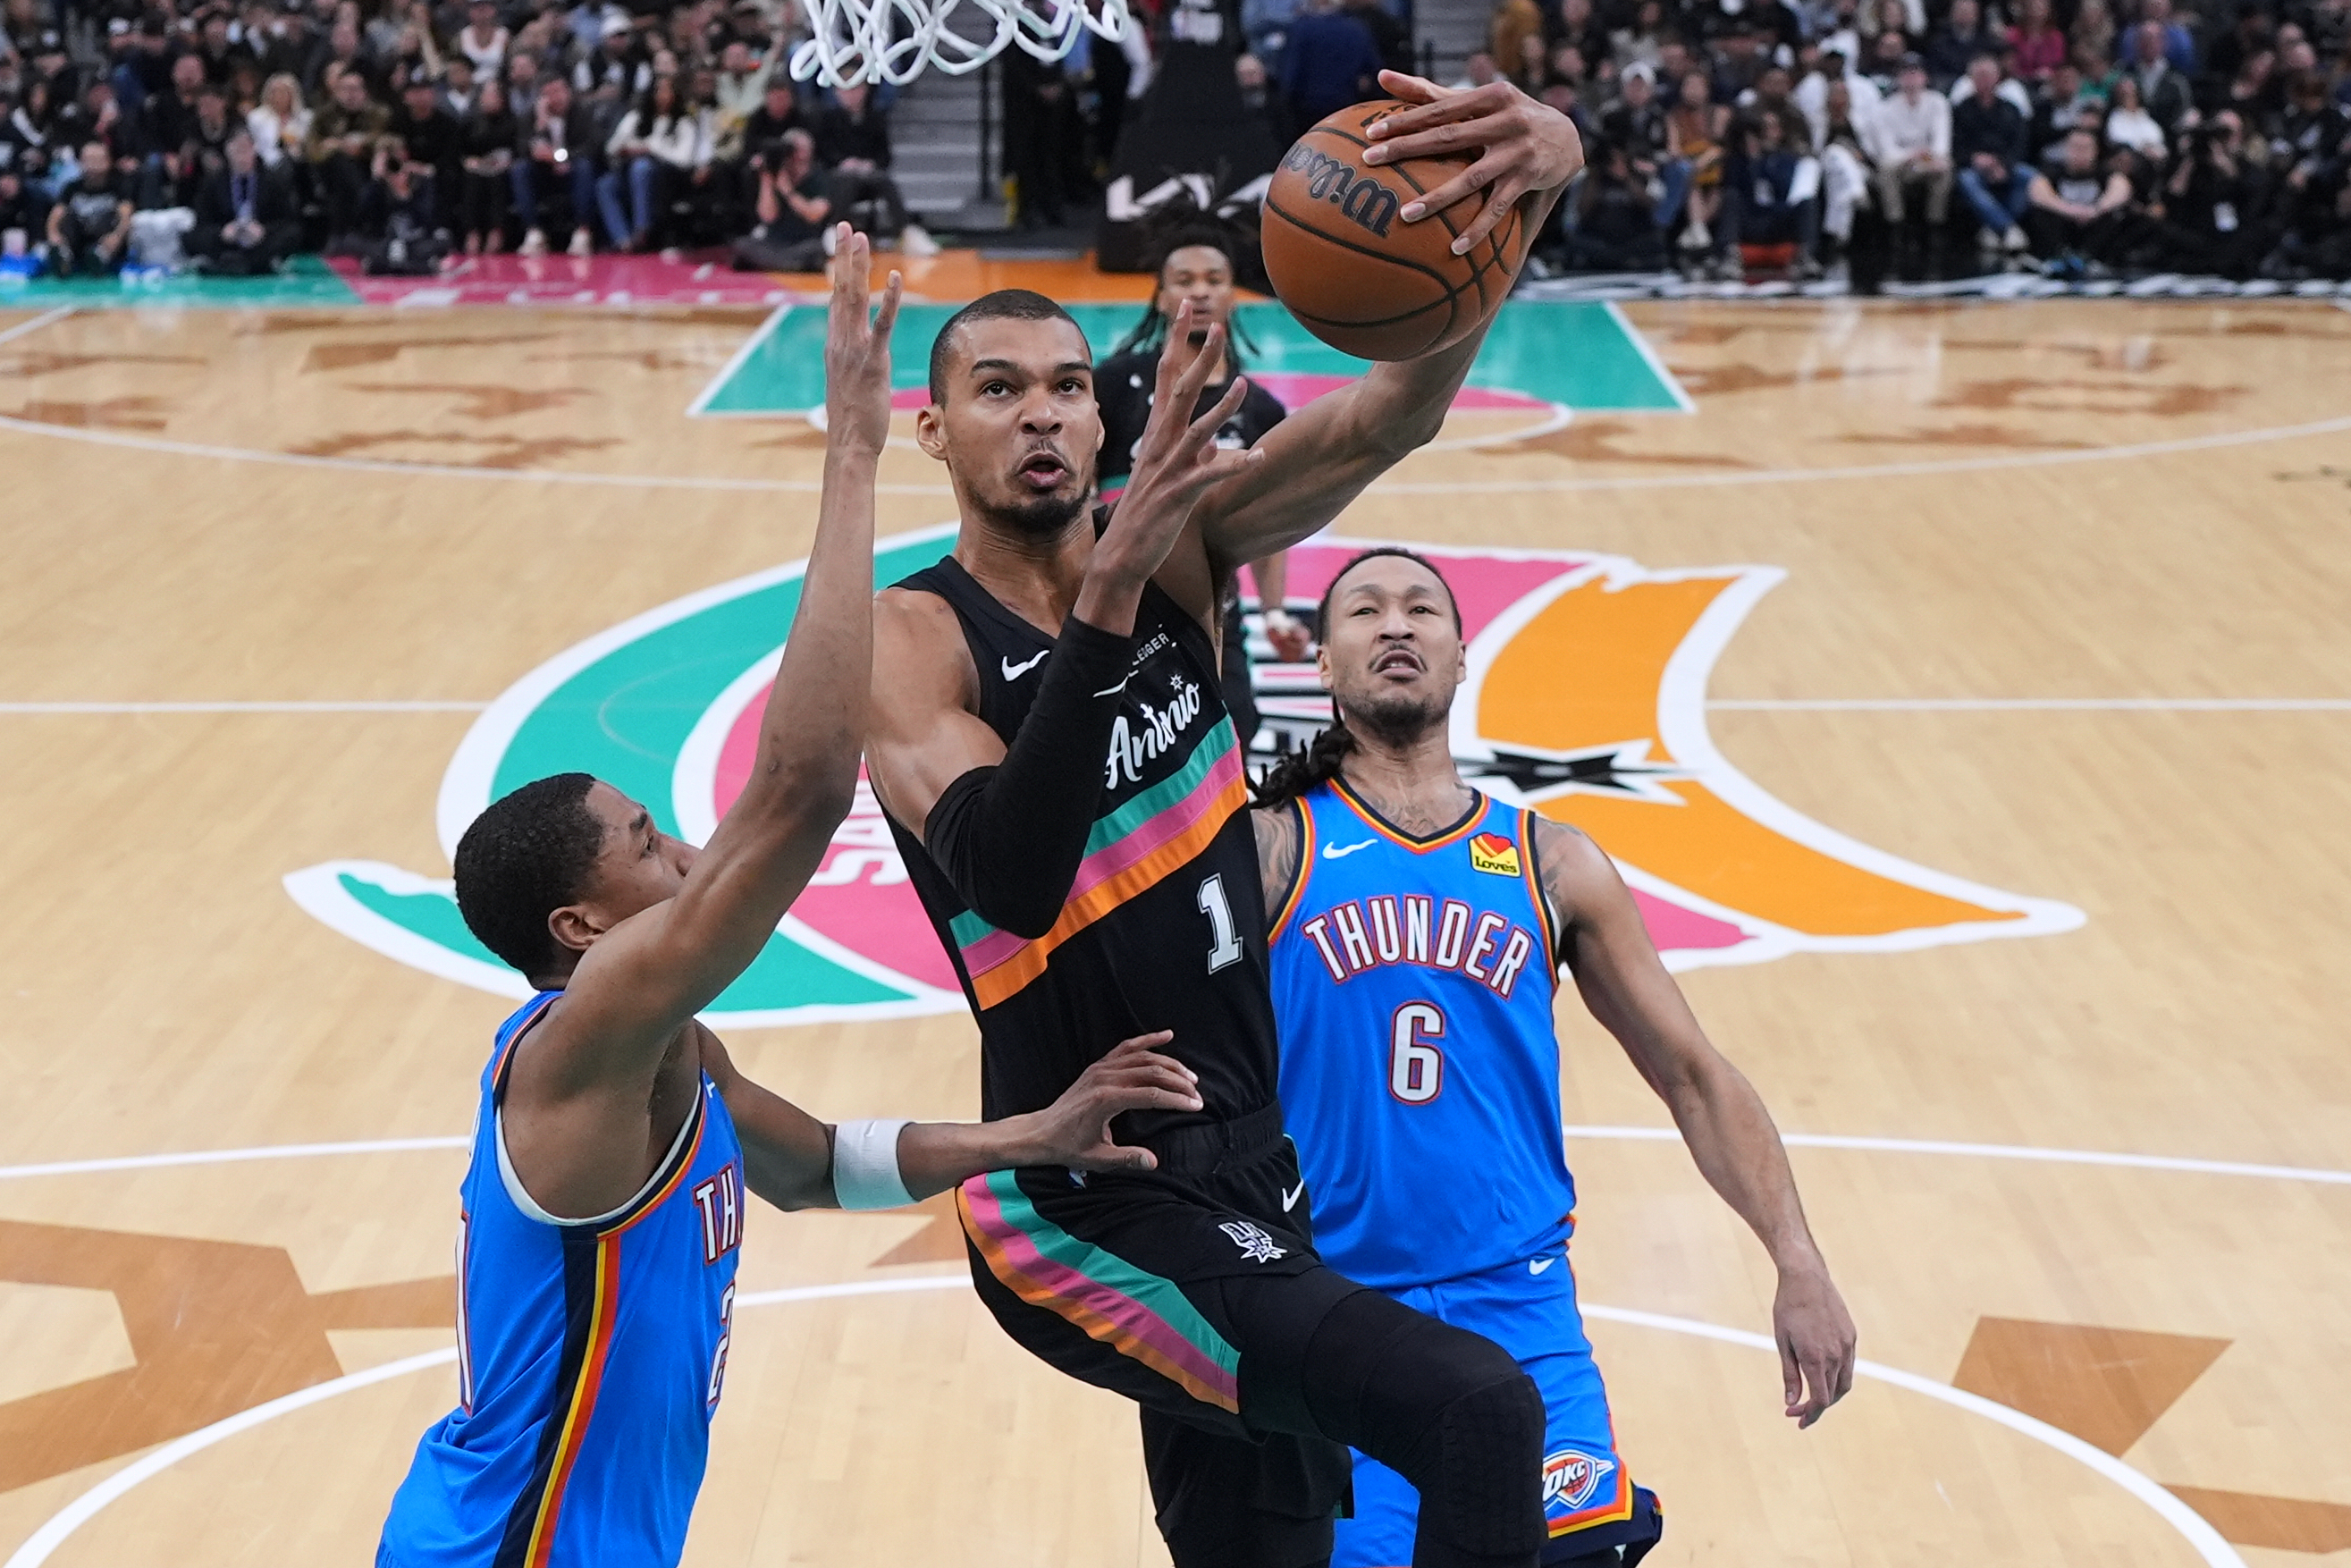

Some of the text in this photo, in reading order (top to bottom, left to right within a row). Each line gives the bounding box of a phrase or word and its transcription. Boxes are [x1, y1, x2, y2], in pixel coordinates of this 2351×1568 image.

[807, 780, 910, 886] SA
[1197, 873, 1243, 975] 1
[1302, 895, 1532, 999] THUNDER
[1388, 1000, 1446, 1105] 6
[1543, 1460, 1586, 1502] OKC
